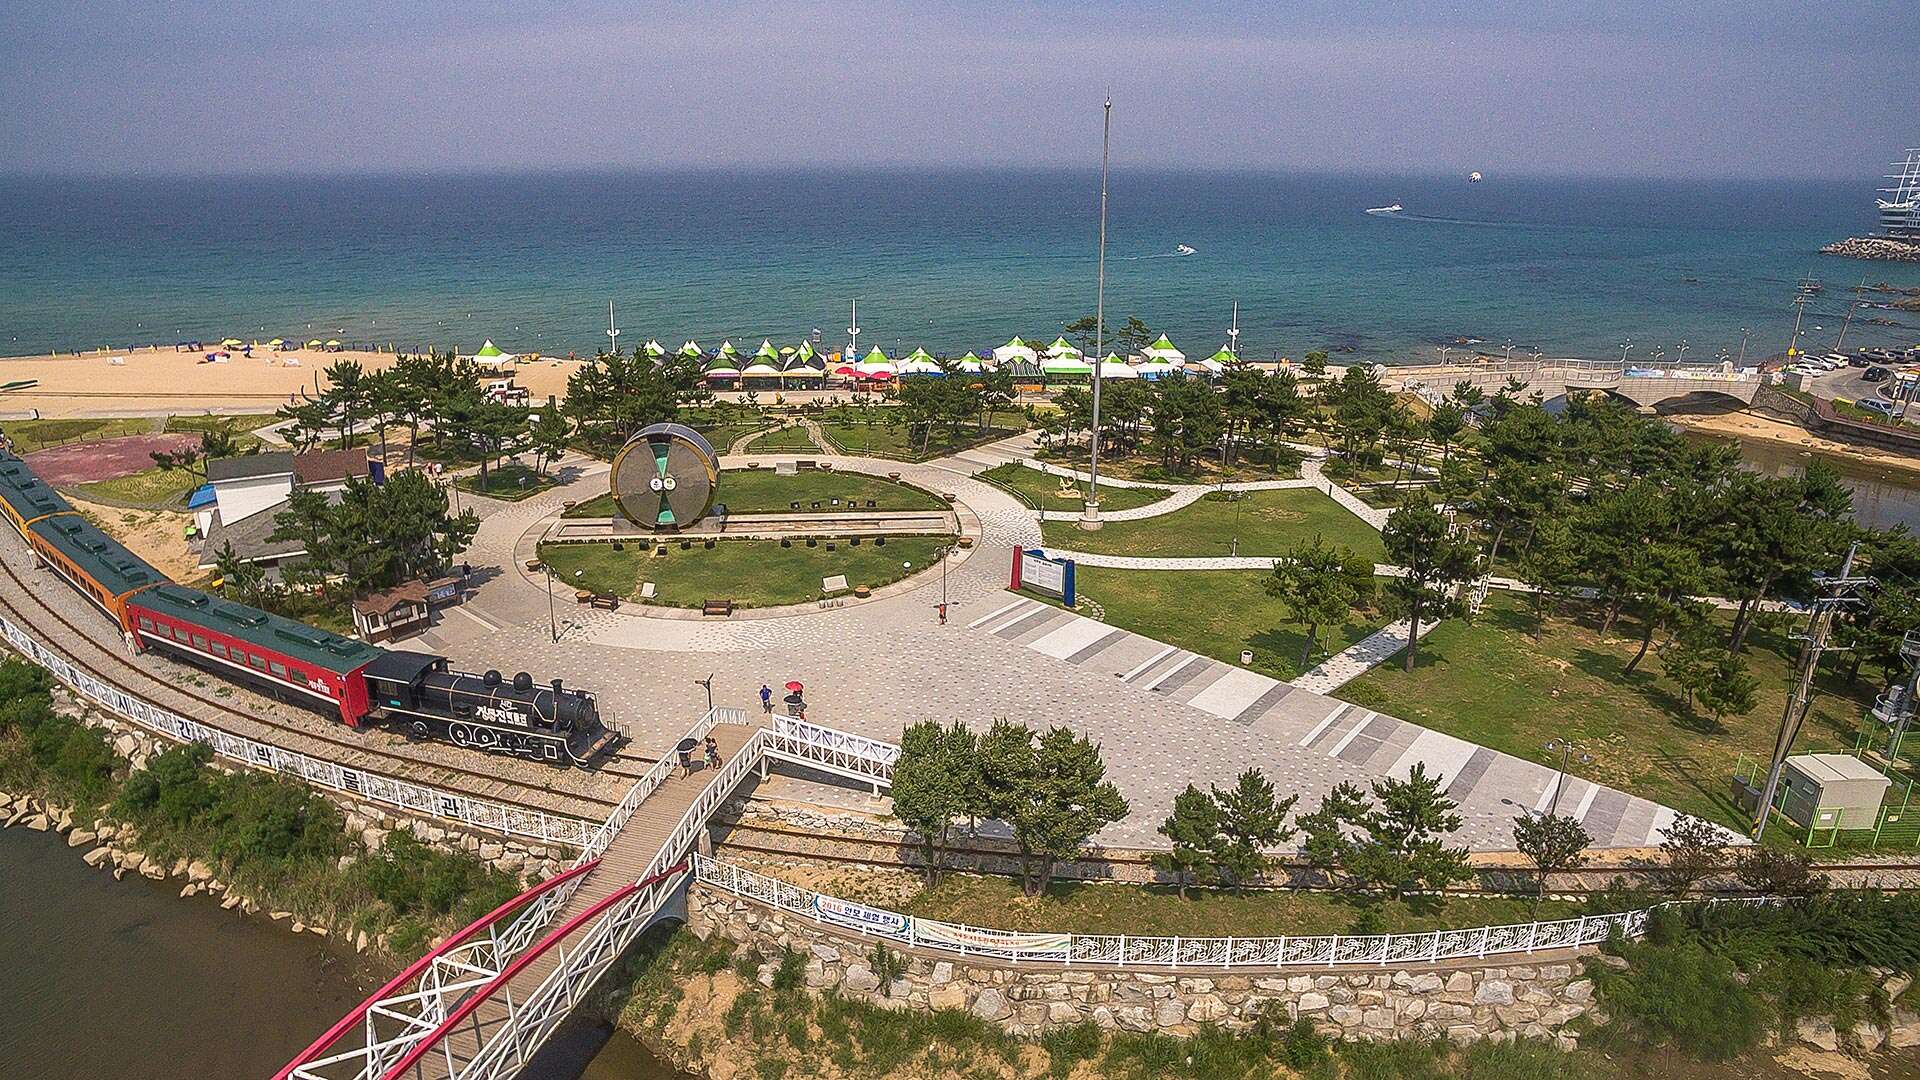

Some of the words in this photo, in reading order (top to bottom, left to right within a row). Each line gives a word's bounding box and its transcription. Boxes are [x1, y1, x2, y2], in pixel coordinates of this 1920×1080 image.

[177, 719, 192, 741] 간
[255, 745, 273, 767] 박
[342, 769, 360, 793] 물
[440, 796, 460, 818] 관
